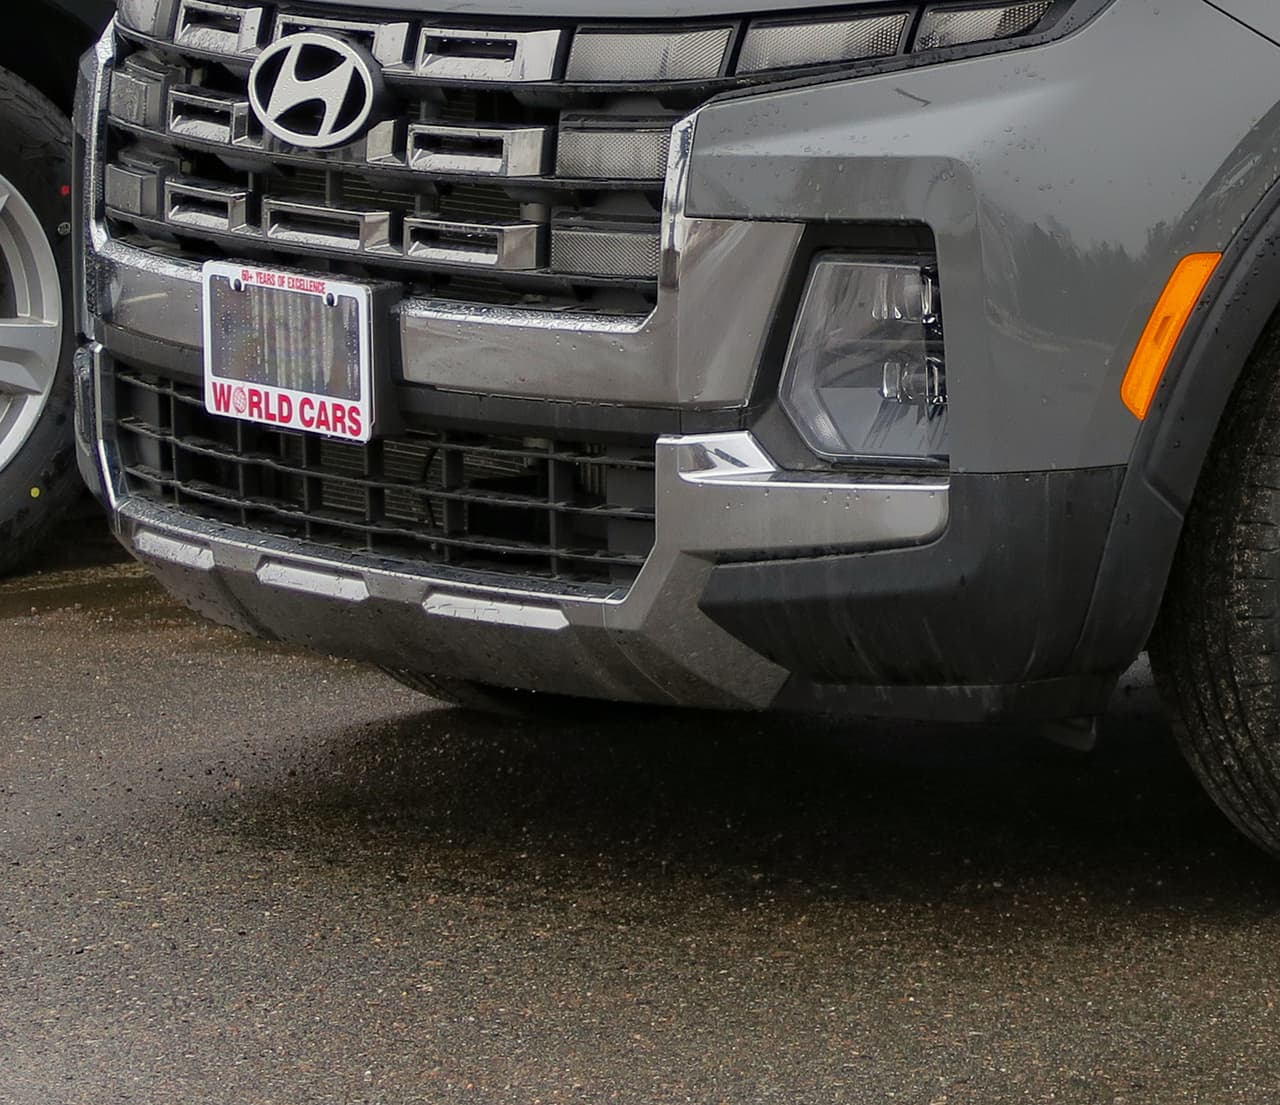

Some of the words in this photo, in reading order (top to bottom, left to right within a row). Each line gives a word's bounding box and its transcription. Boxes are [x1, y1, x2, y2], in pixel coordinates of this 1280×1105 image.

[255, 271, 276, 286] YEARS
[277, 275, 286, 287] OF
[287, 276, 326, 294] EXCELLENCE
[299, 397, 362, 437] CARS
